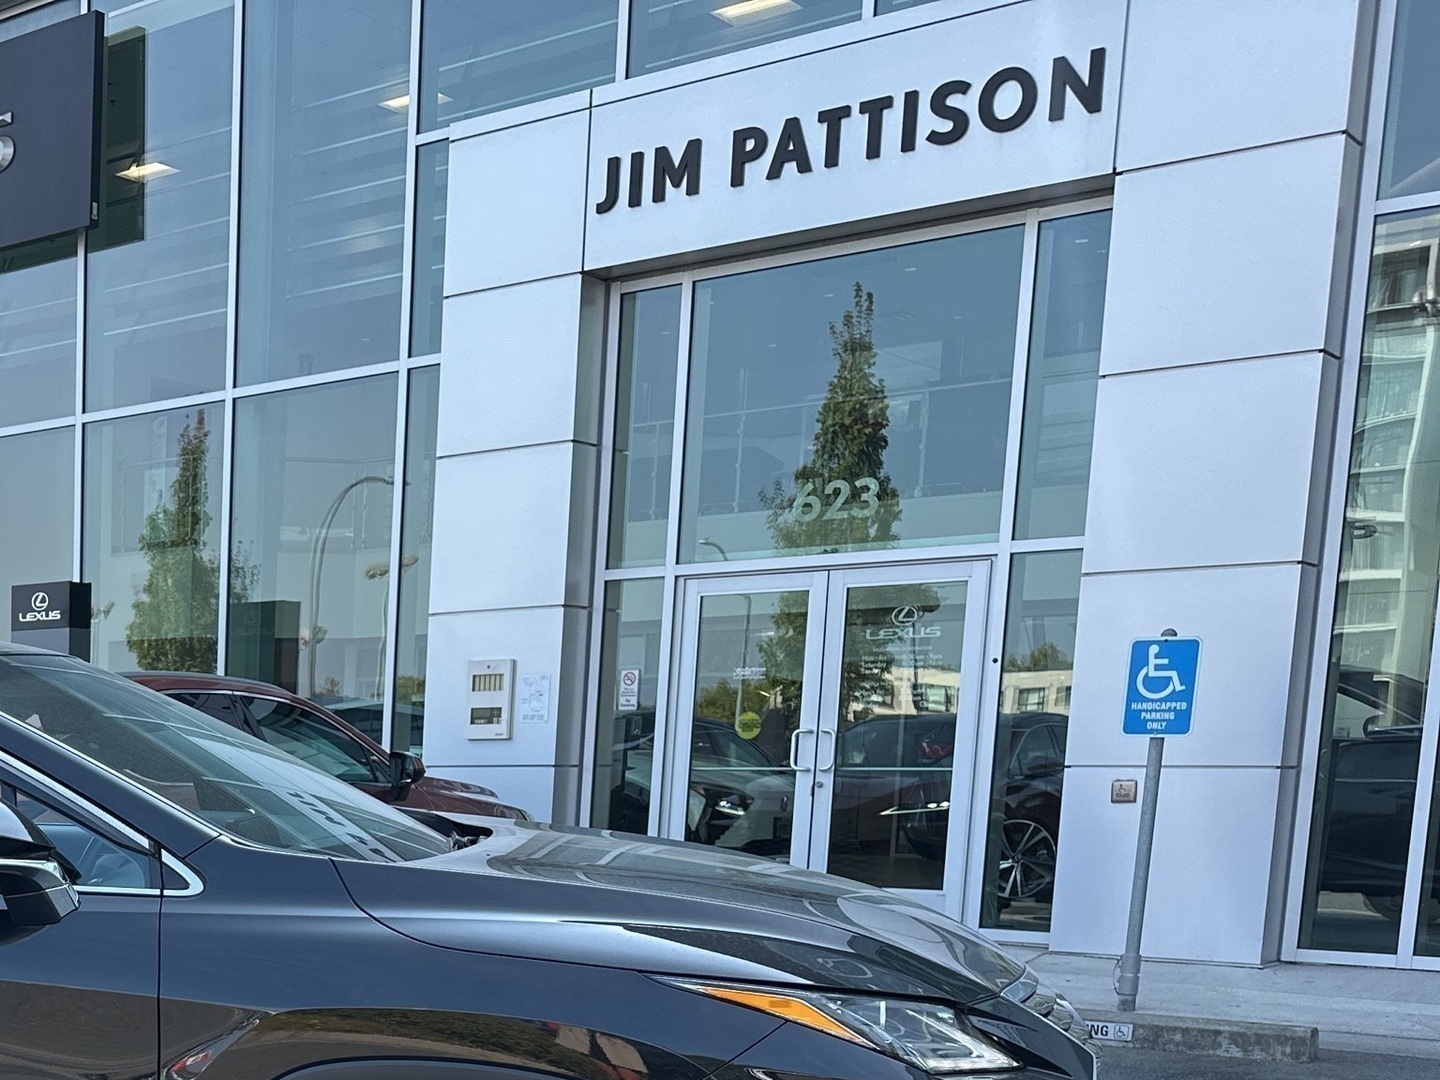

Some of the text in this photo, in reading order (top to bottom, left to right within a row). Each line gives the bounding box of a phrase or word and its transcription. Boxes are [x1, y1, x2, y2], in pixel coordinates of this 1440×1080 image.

[596, 47, 1107, 214] JIM PATTISON
[793, 477, 879, 522] 623
[19, 610, 61, 621] LEXUS
[866, 627, 941, 639] LEXUS
[1131, 702, 1187, 710] HANDICAPPED
[1141, 712, 1175, 720] PARKING
[1146, 721, 1167, 730] ONLY
